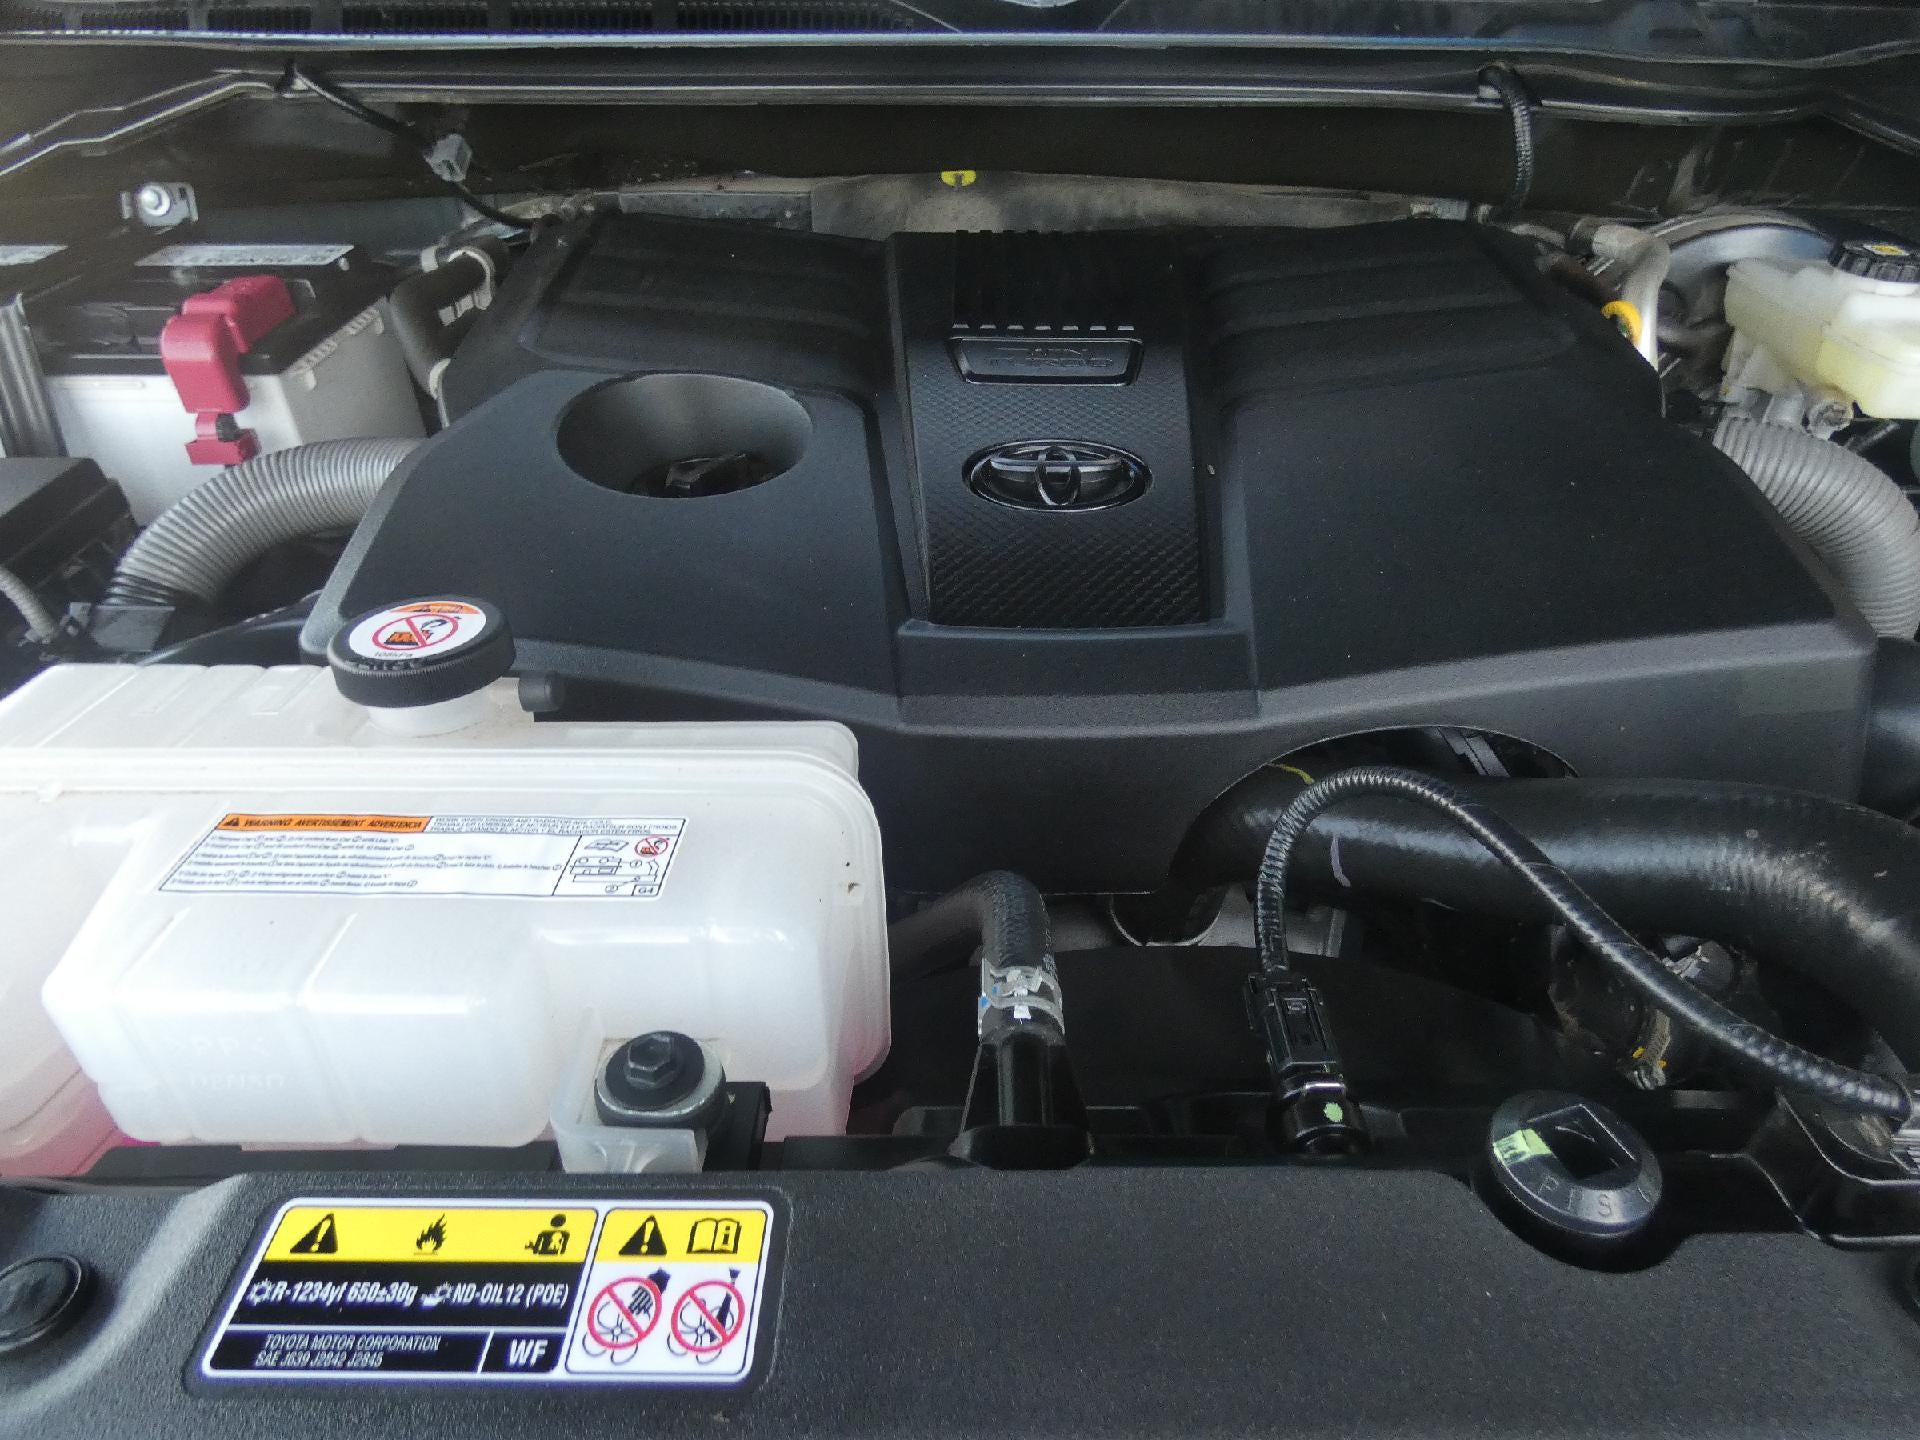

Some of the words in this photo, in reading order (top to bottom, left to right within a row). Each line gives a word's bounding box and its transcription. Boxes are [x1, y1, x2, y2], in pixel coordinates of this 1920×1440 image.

[270, 1281, 348, 1307] R-1234yf
[525, 1282, 570, 1310] (POE)
[264, 1334, 310, 1351] TOYOTA
[311, 1334, 356, 1351] MOTOR
[357, 1335, 442, 1352] CORPORATION
[508, 1339, 549, 1368] WF
[255, 1351, 282, 1367] SAE
